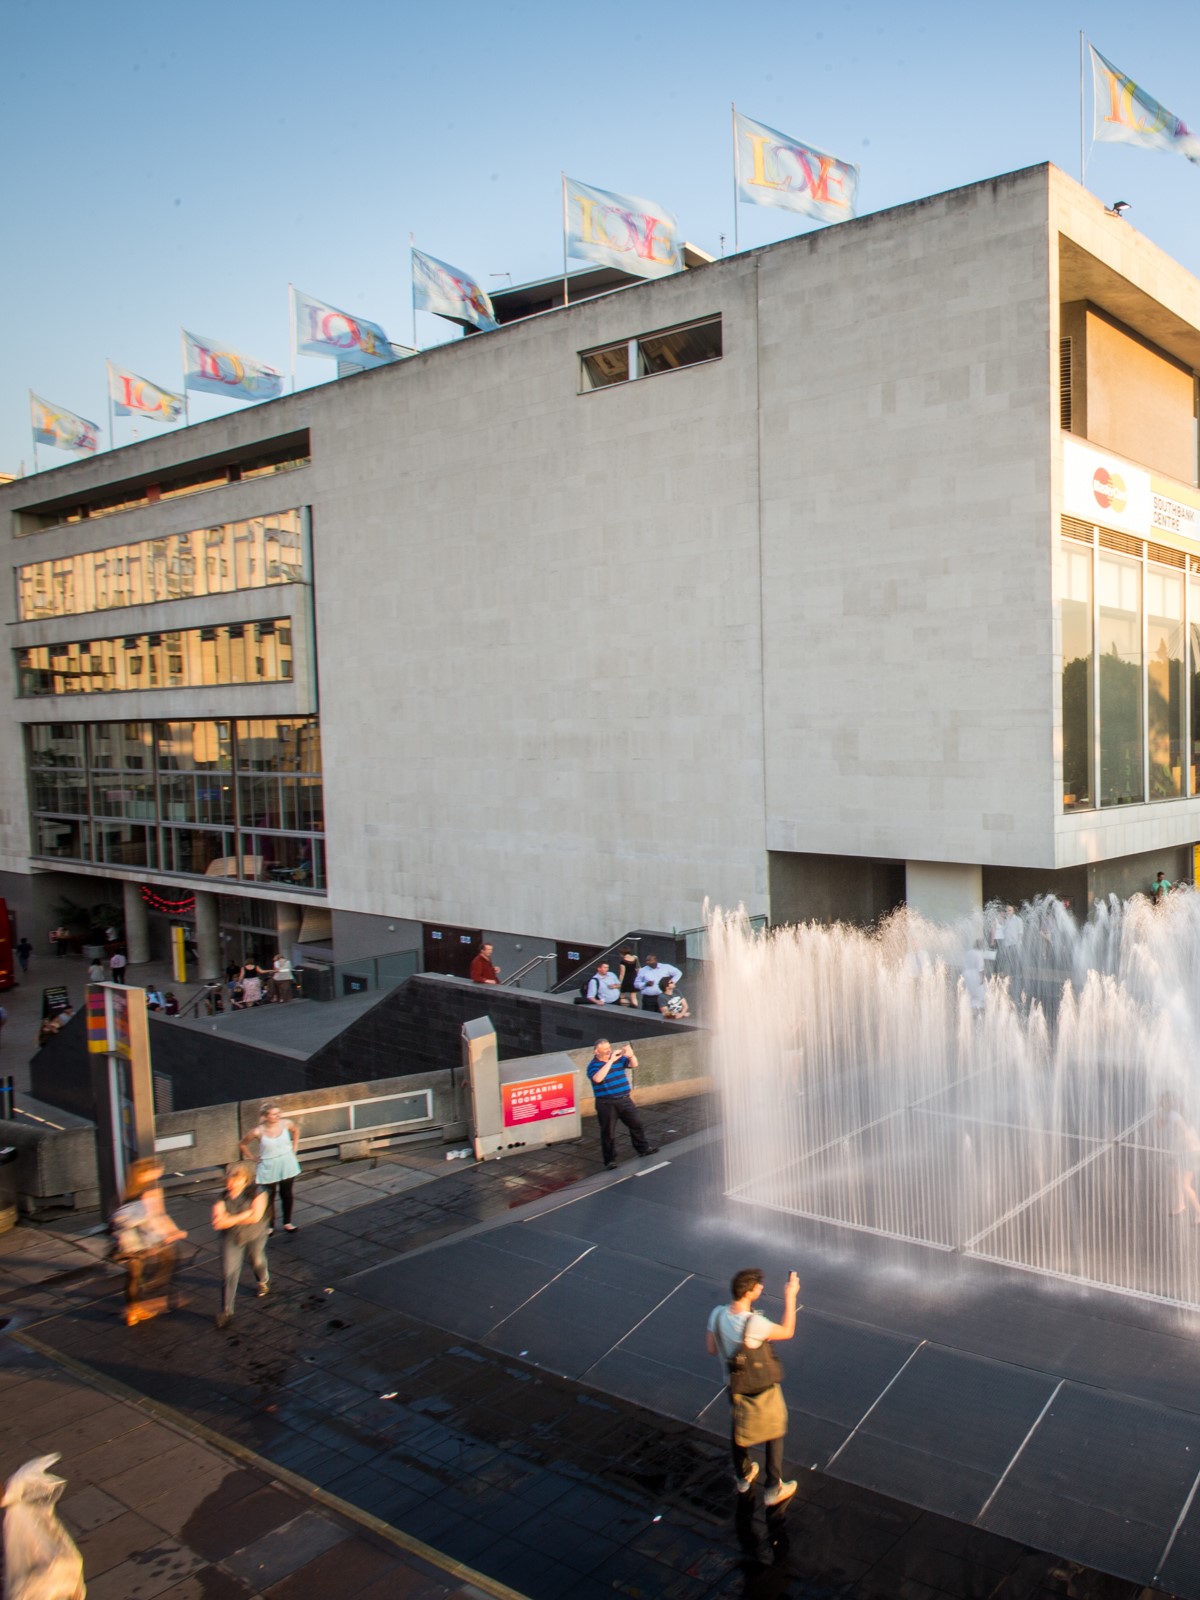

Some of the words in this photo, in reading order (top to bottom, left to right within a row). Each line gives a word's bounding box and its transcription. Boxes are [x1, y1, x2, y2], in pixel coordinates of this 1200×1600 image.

[746, 132, 850, 209] LOVE
[575, 196, 677, 266] LOVE
[1153, 496, 1196, 522] SOUTHBANK
[1153, 511, 1181, 532] CENTRE
[511, 1083, 564, 1098] APPEARING
[511, 1094, 543, 1105] ROOMS
